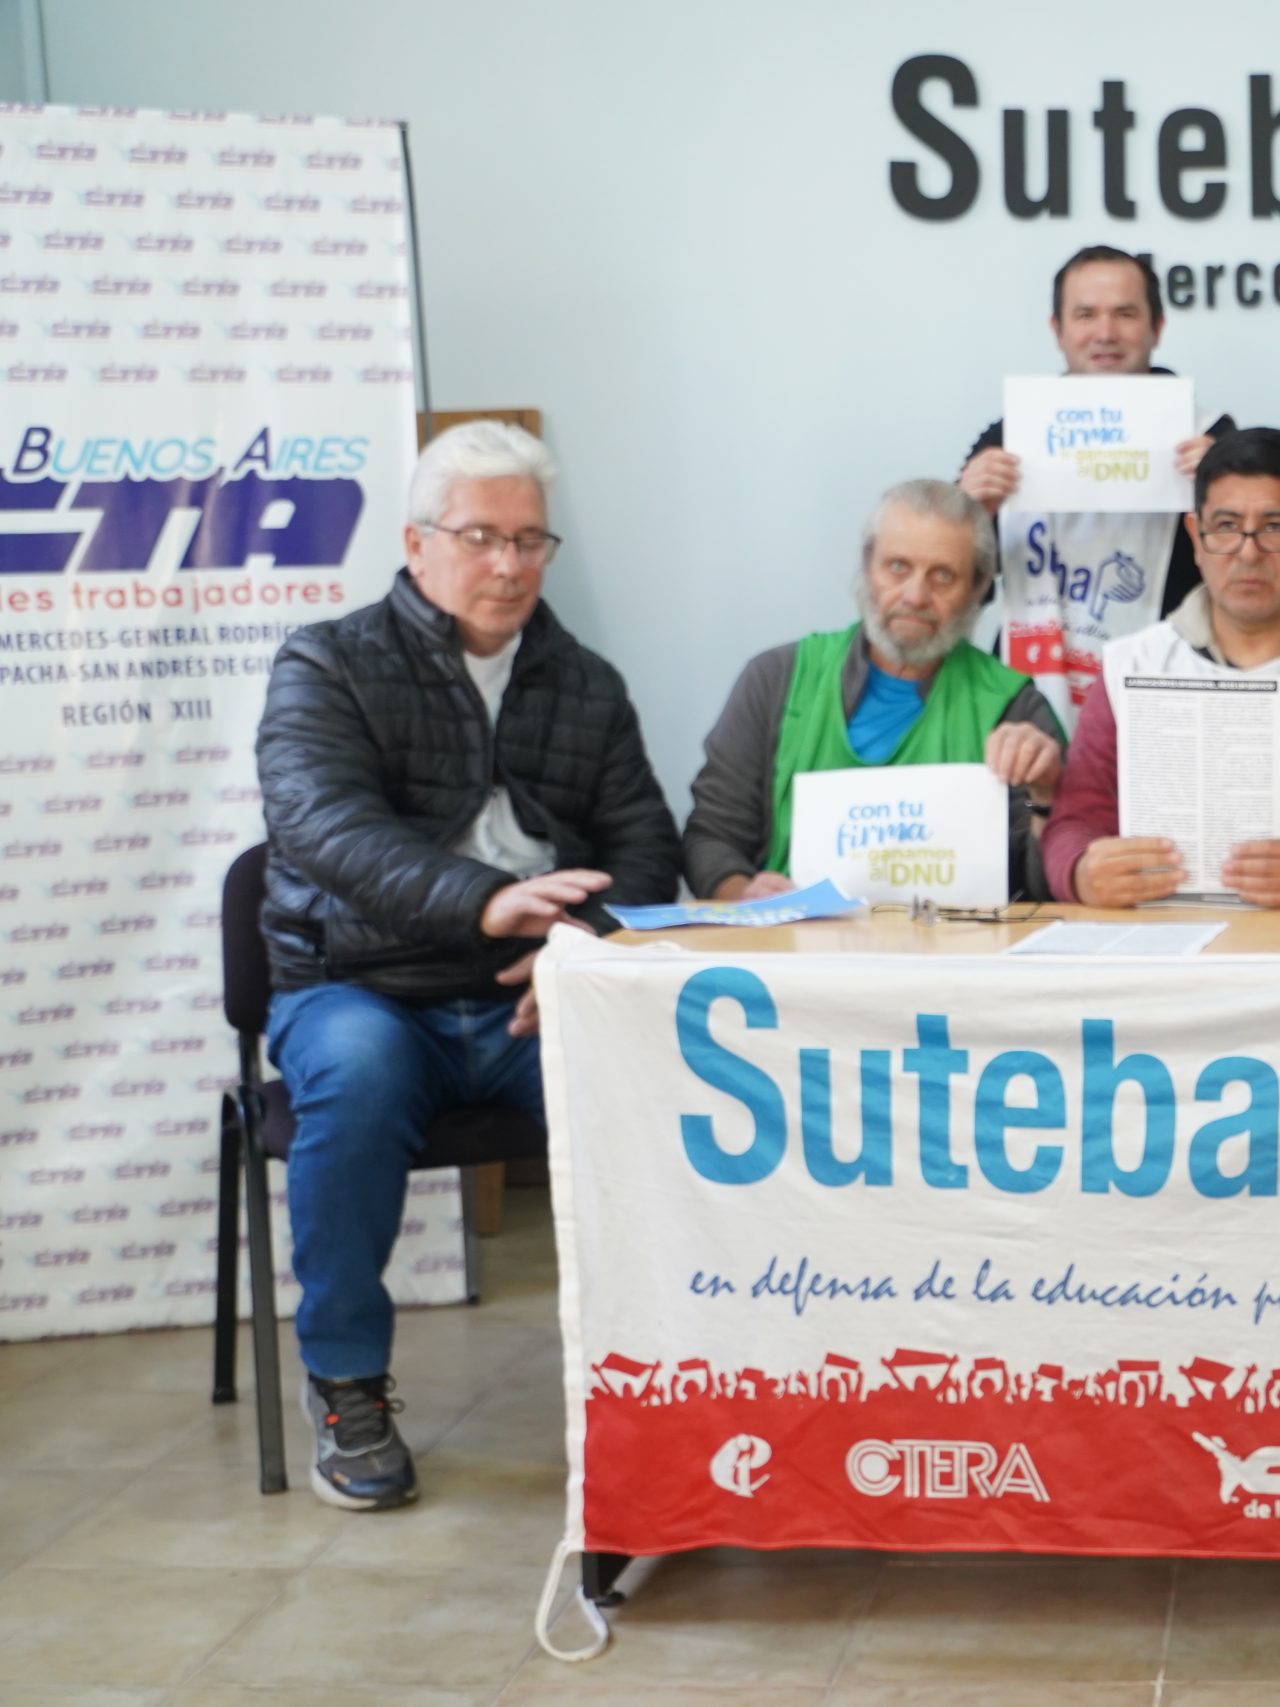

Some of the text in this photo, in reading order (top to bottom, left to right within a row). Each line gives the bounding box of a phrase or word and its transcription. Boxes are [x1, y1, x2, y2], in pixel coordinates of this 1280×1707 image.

[1056, 406, 1122, 423] con tu
[232, 425, 370, 473] AIRES
[70, 577, 345, 614] trabajadores
[127, 655, 208, 680] ANDRÉS
[213, 656, 238, 677] DE
[62, 698, 213, 727] REGIÓN XIII
[849, 801, 924, 819] con tu
[890, 864, 955, 886] DNU
[676, 966, 1280, 1199] Suteba
[690, 1270, 736, 1297] en
[751, 1256, 898, 1316] defensa
[914, 1260, 956, 1300] de
[972, 1258, 1016, 1302] la
[1031, 1263, 1239, 1308] educación
[845, 1438, 1051, 1504] CTERA
[1243, 1501, 1271, 1519] de
